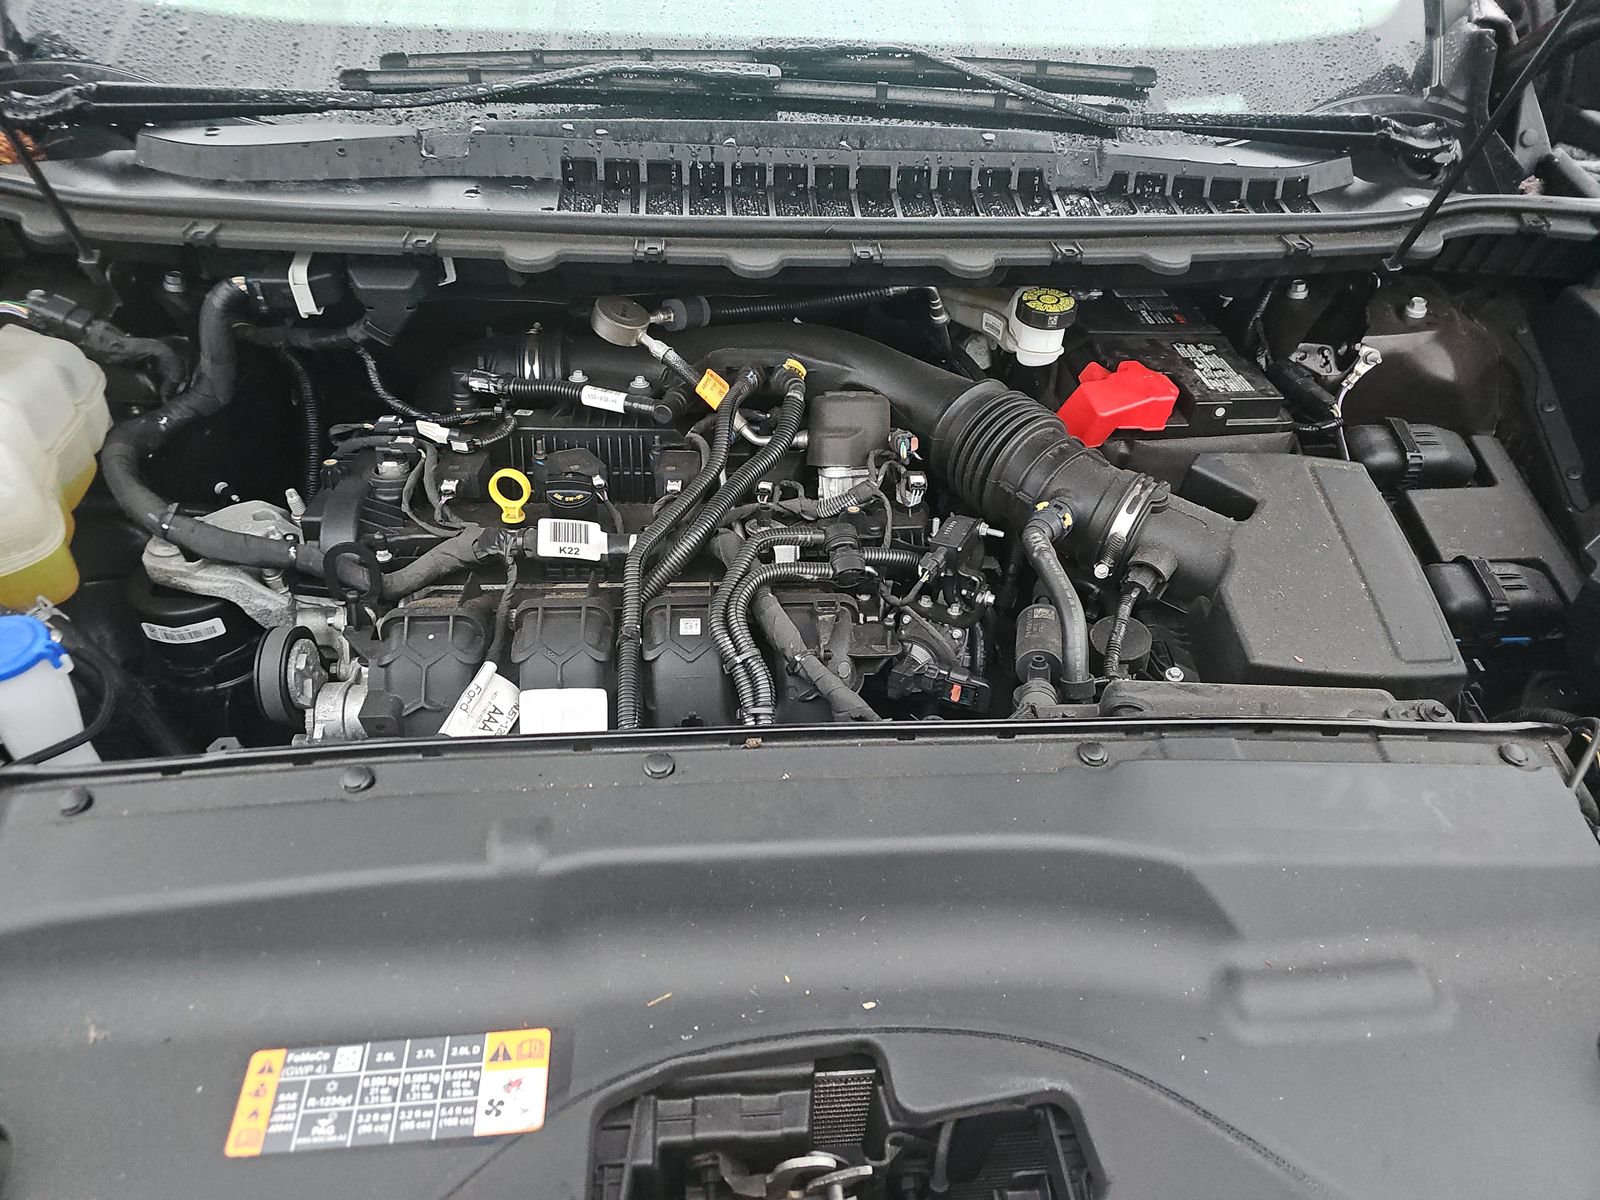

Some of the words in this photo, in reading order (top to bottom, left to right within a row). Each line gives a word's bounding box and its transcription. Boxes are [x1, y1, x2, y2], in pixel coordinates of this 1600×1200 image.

[560, 546, 580, 556] K22
[460, 683, 482, 713] Ford
[479, 704, 505, 732] AAA
